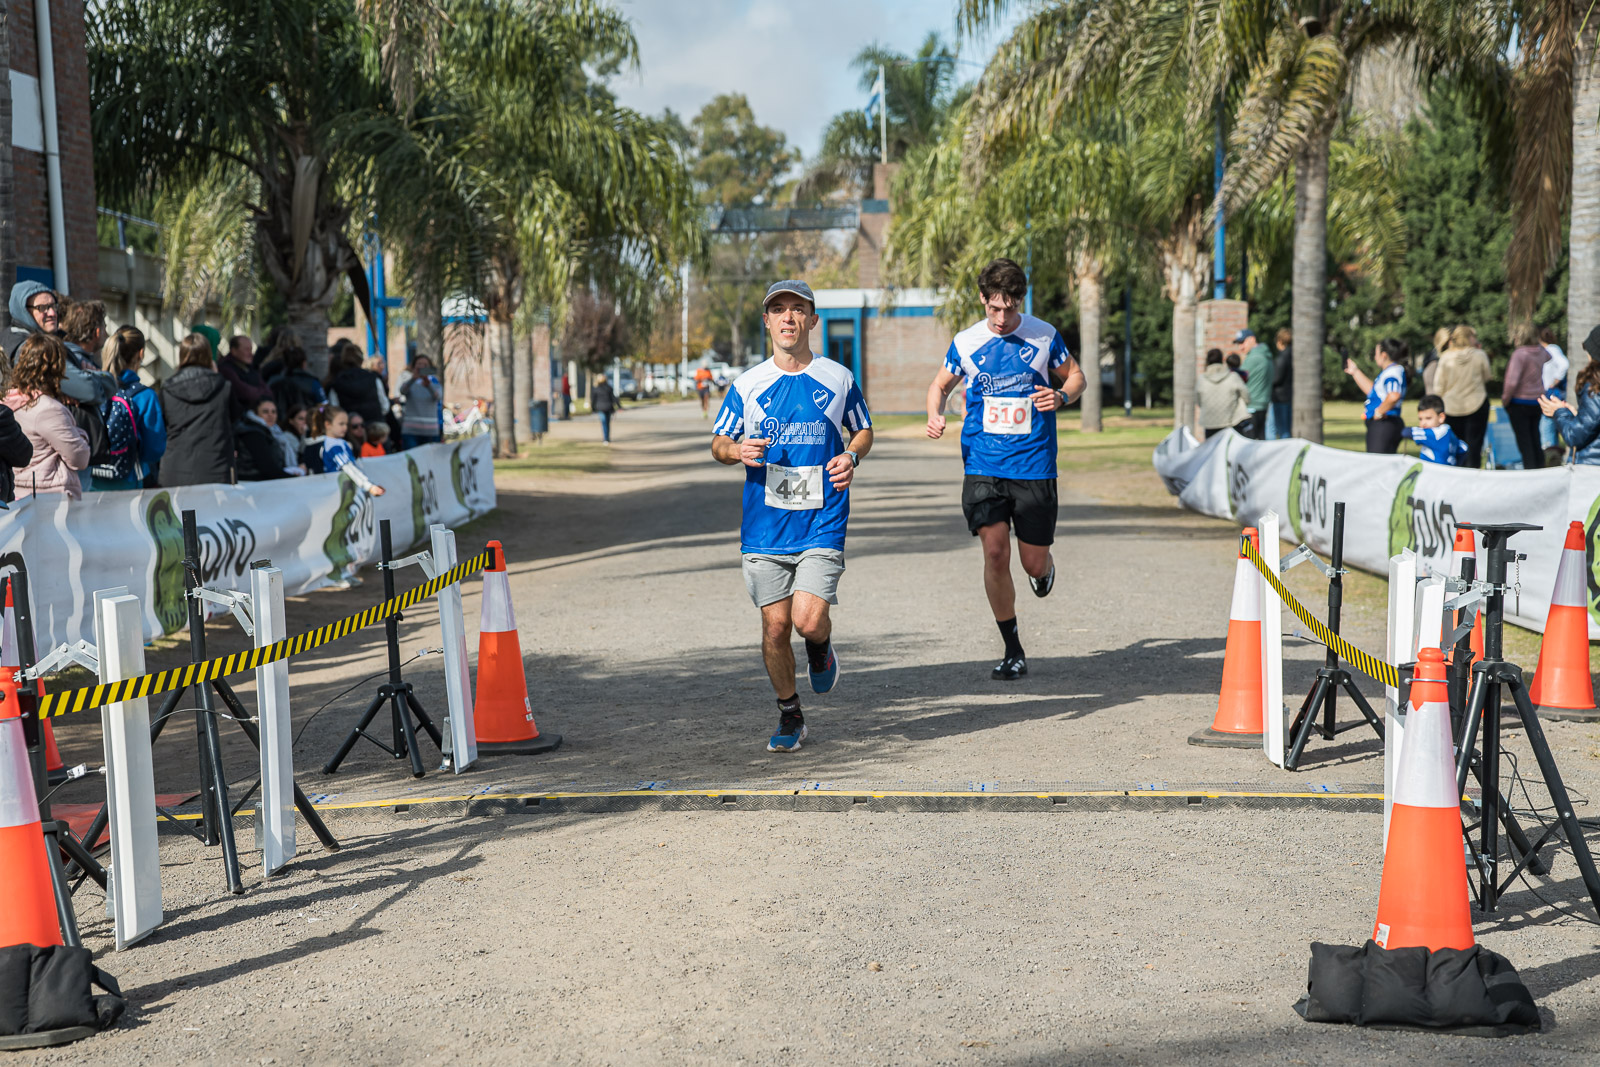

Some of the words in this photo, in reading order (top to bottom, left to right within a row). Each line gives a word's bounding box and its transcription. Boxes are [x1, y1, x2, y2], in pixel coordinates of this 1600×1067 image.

[978, 372, 993, 396] 3
[988, 406, 1027, 425] 510
[764, 417, 779, 448] 3
[776, 478, 811, 500] 44
